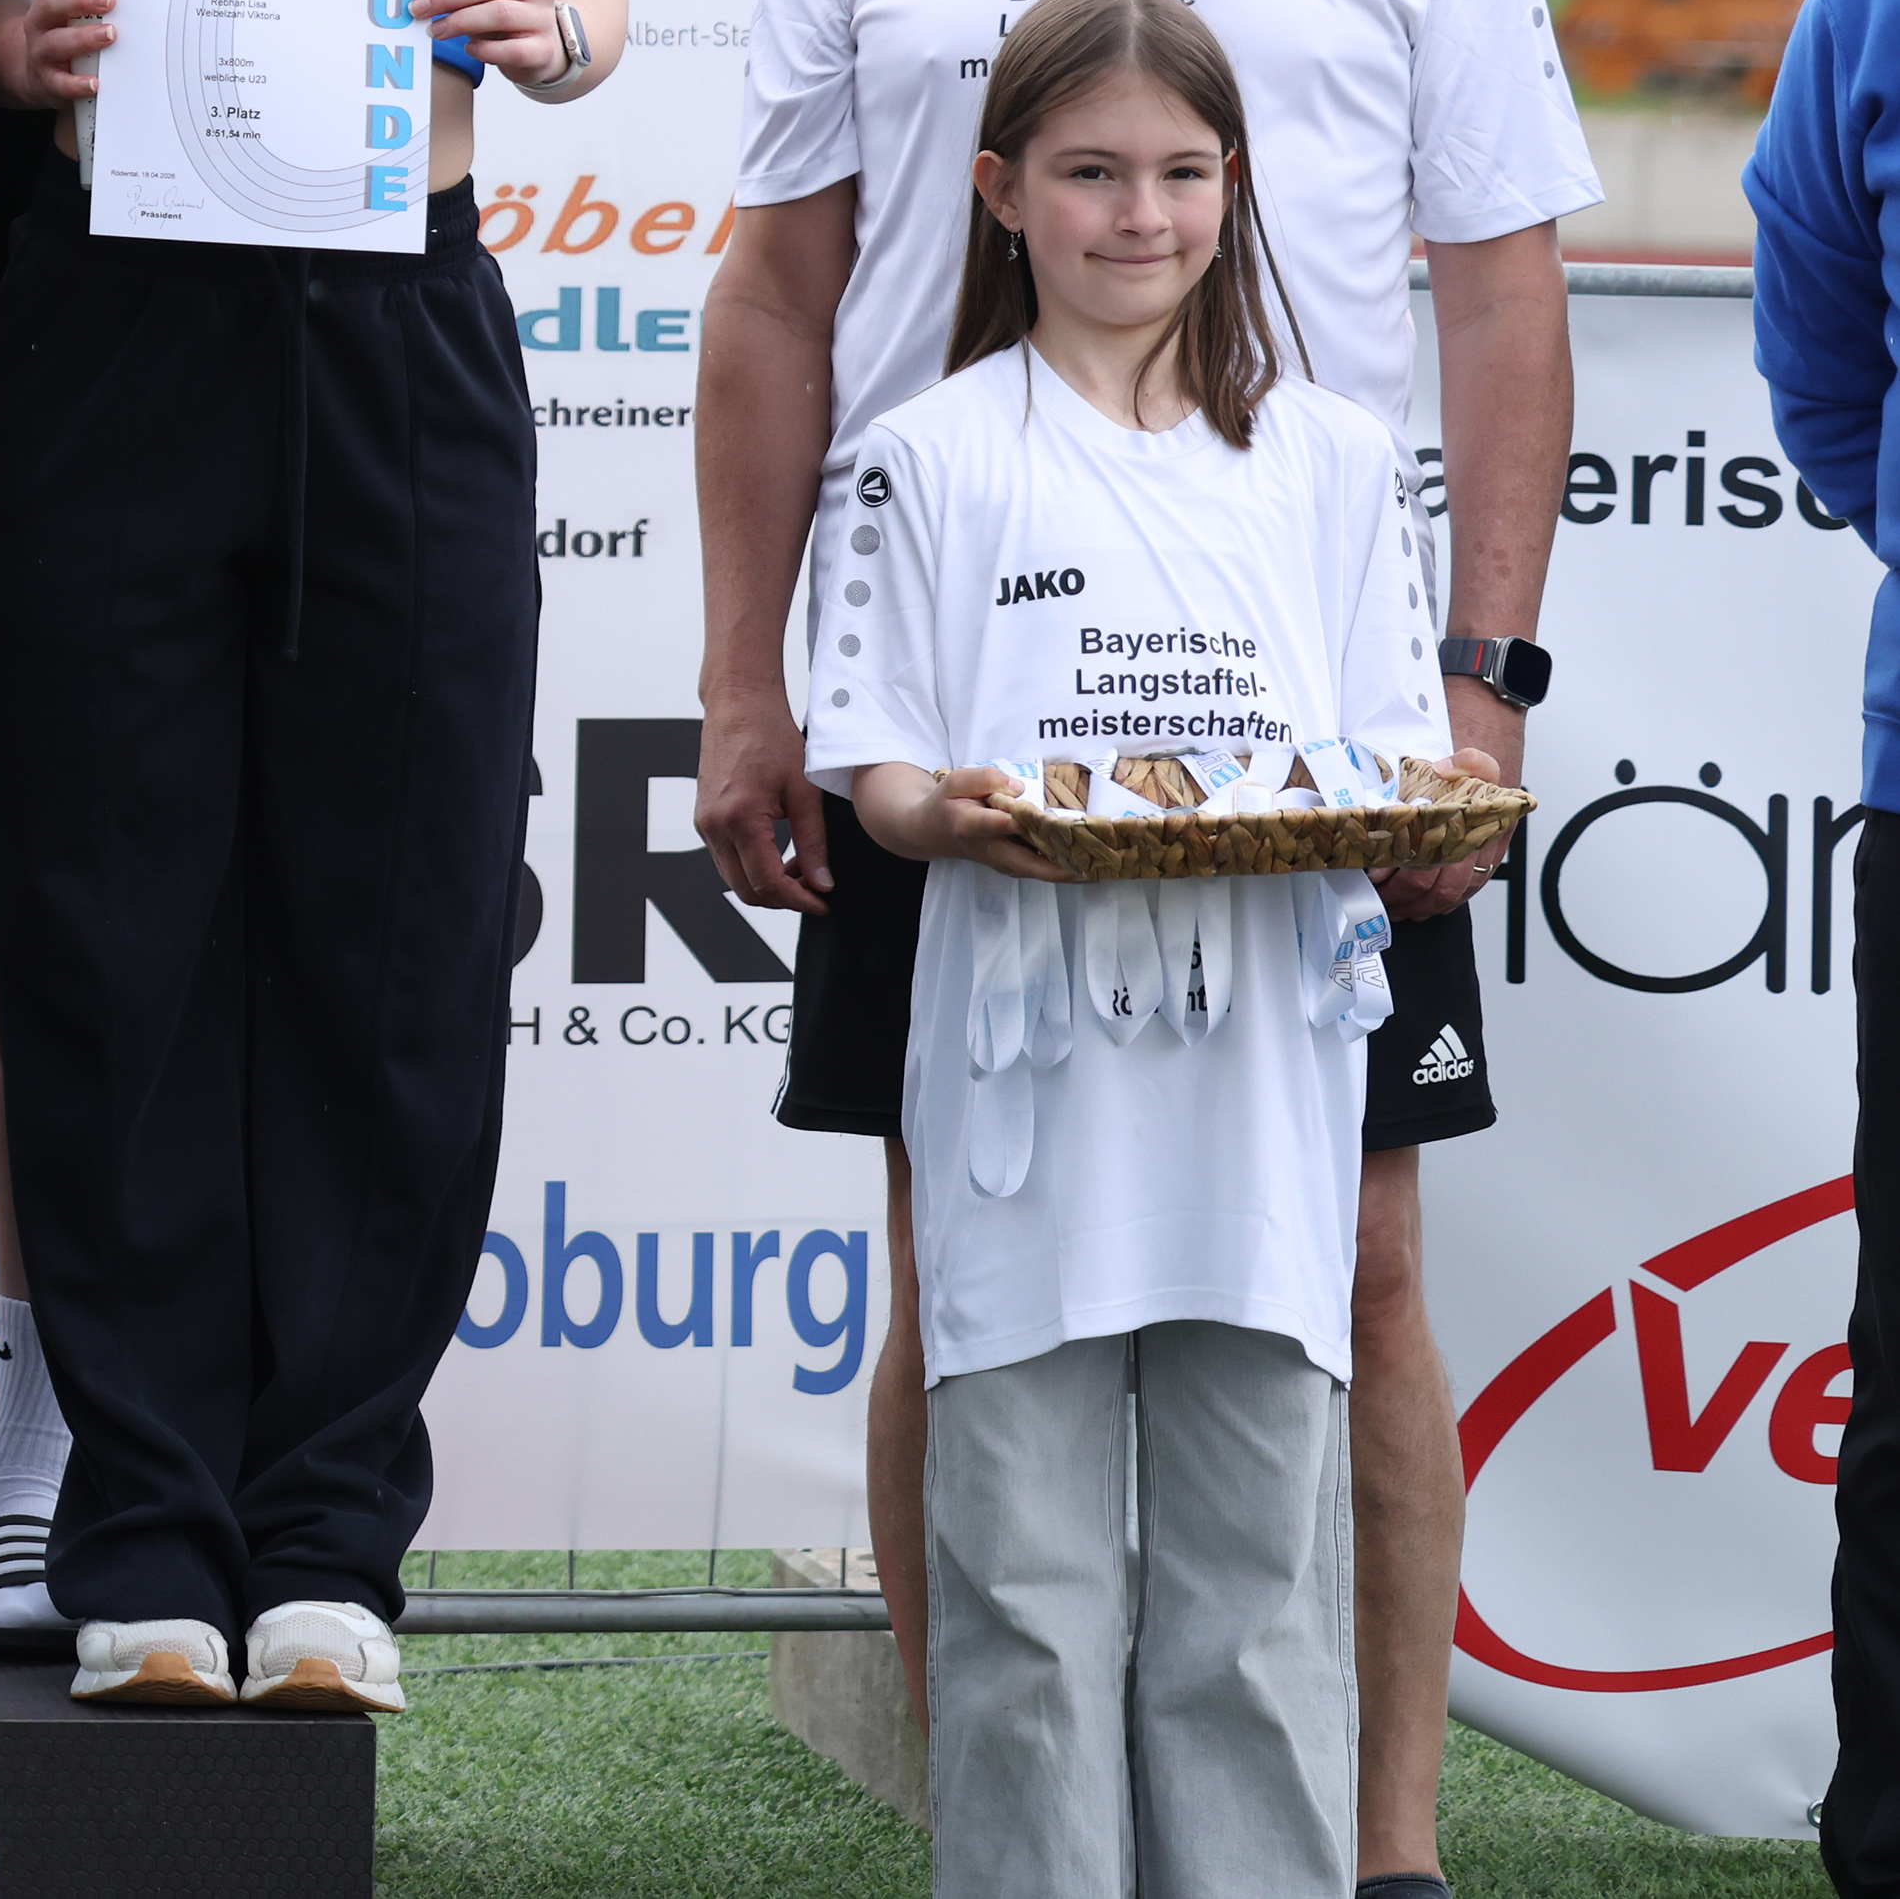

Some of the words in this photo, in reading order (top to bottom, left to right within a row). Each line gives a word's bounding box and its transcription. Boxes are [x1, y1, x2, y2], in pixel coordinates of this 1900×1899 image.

[210, 107, 222, 119] 3.
[226, 107, 261, 120] Platz
[995, 568, 1086, 607] JAKO
[1080, 627, 1257, 660] Bayerische
[1075, 668, 1267, 701] Langstaffel-
[1037, 708, 1293, 745] meisterschaften
[564, 1006, 600, 1045] &
[620, 1005, 707, 1045] Co.
[726, 1005, 793, 1045] KG
[1412, 1057, 1475, 1086] adidas
[456, 1181, 870, 1397] oburg
